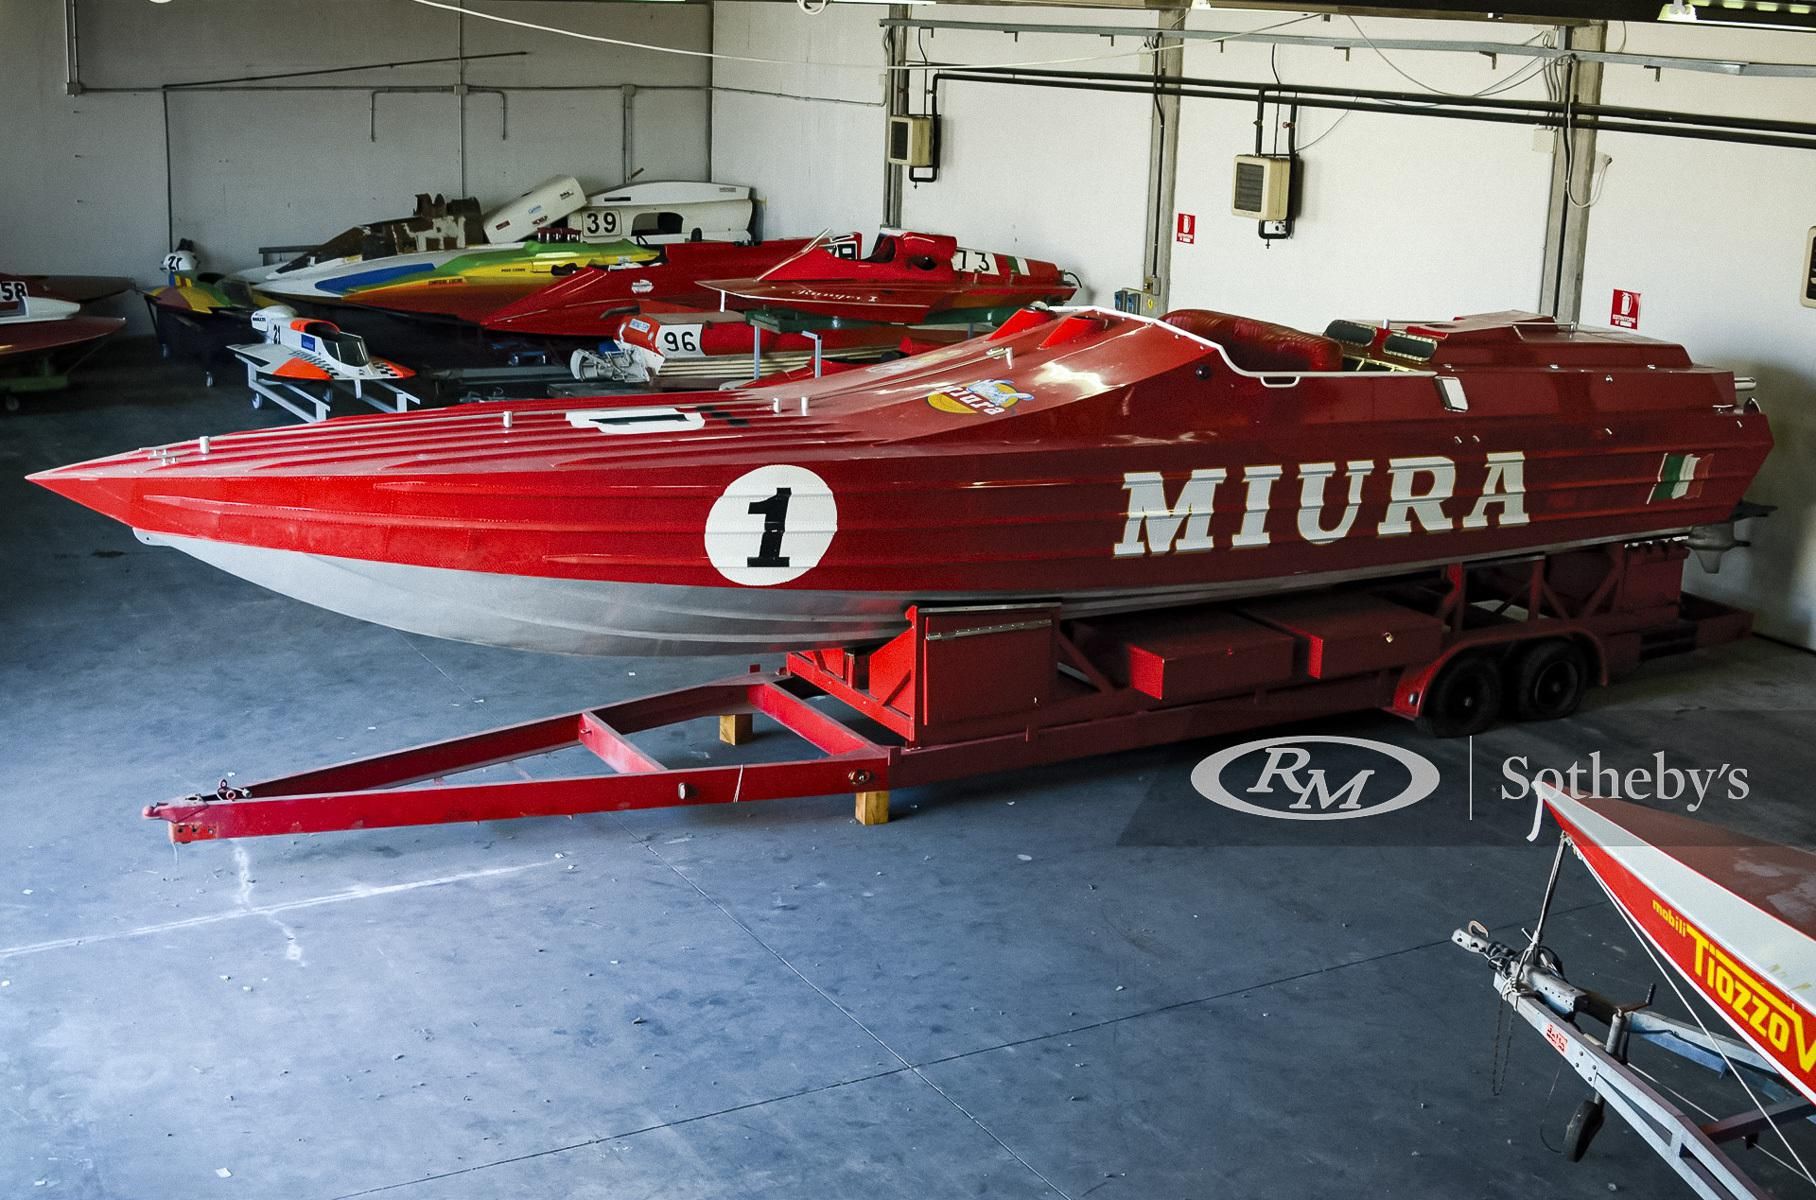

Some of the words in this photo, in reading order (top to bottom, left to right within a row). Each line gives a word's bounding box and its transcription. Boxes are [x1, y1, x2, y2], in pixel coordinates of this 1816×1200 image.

[587, 212, 616, 234] 39
[955, 250, 990, 271] 73
[0, 282, 27, 301] 58
[273, 324, 281, 344] 21
[664, 331, 697, 352] 96
[1112, 451, 1531, 556] MIURA
[747, 487, 792, 568] 1
[1652, 899, 1687, 938] mobili
